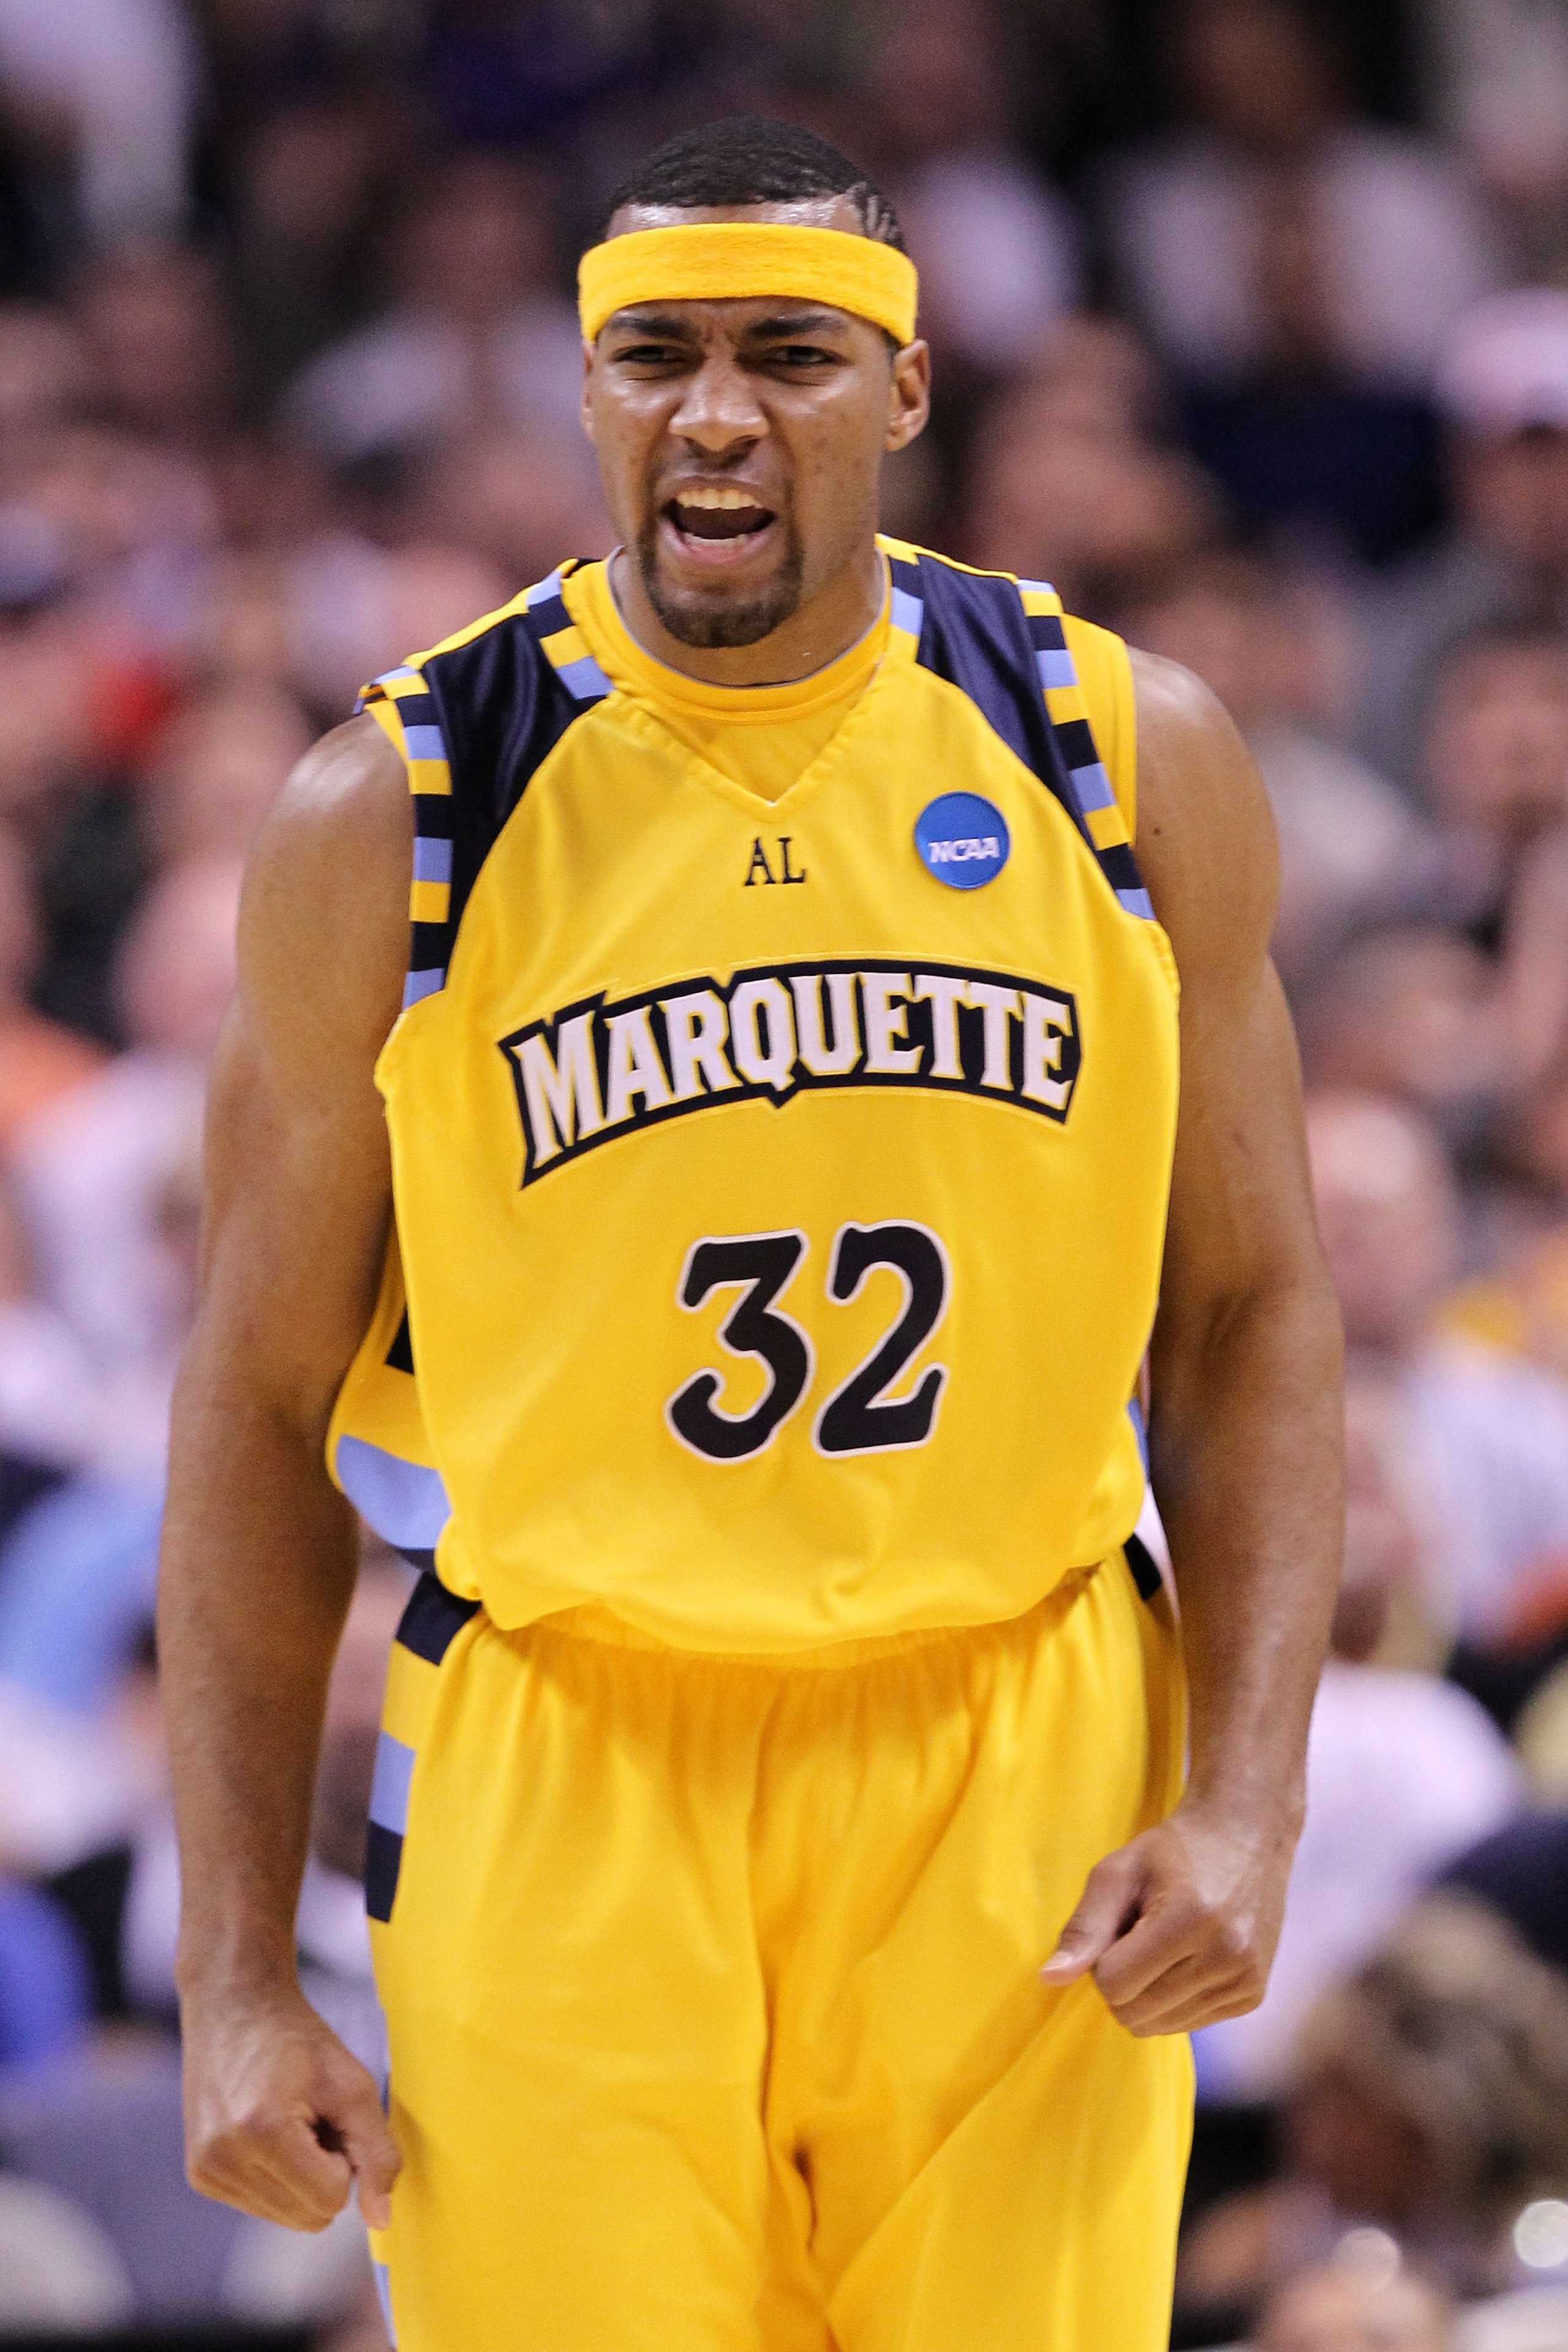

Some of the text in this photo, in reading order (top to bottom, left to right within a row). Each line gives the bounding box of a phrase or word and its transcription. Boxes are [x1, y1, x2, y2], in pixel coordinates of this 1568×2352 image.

[744, 836, 807, 887] AL
[927, 837, 1001, 863] NCAA
[511, 971, 1074, 1169] MARQUETTE
[665, 1219, 951, 1463] 32
